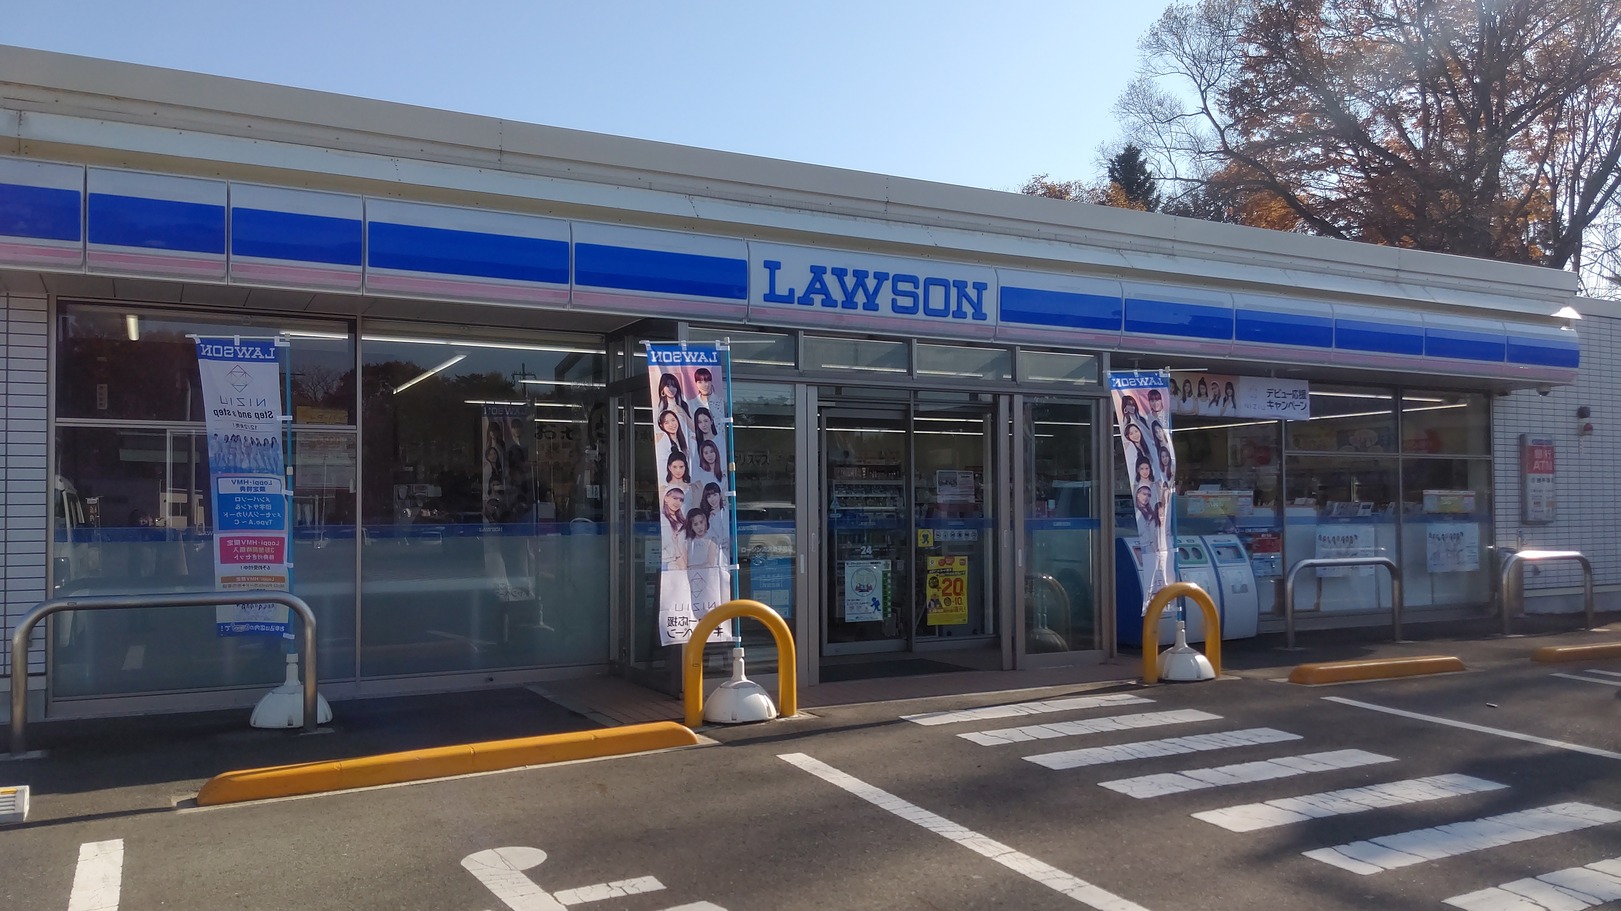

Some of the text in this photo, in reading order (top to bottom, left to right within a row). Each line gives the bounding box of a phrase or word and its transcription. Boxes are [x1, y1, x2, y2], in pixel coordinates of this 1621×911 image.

[763, 260, 988, 321] LAWSON
[1266, 388, 1307, 400] デビュー応援
[1266, 400, 1307, 411] キャンペーン
[1533, 460, 1553, 471] ATM
[860, 545, 873, 555] 24
[941, 577, 964, 597] 20
